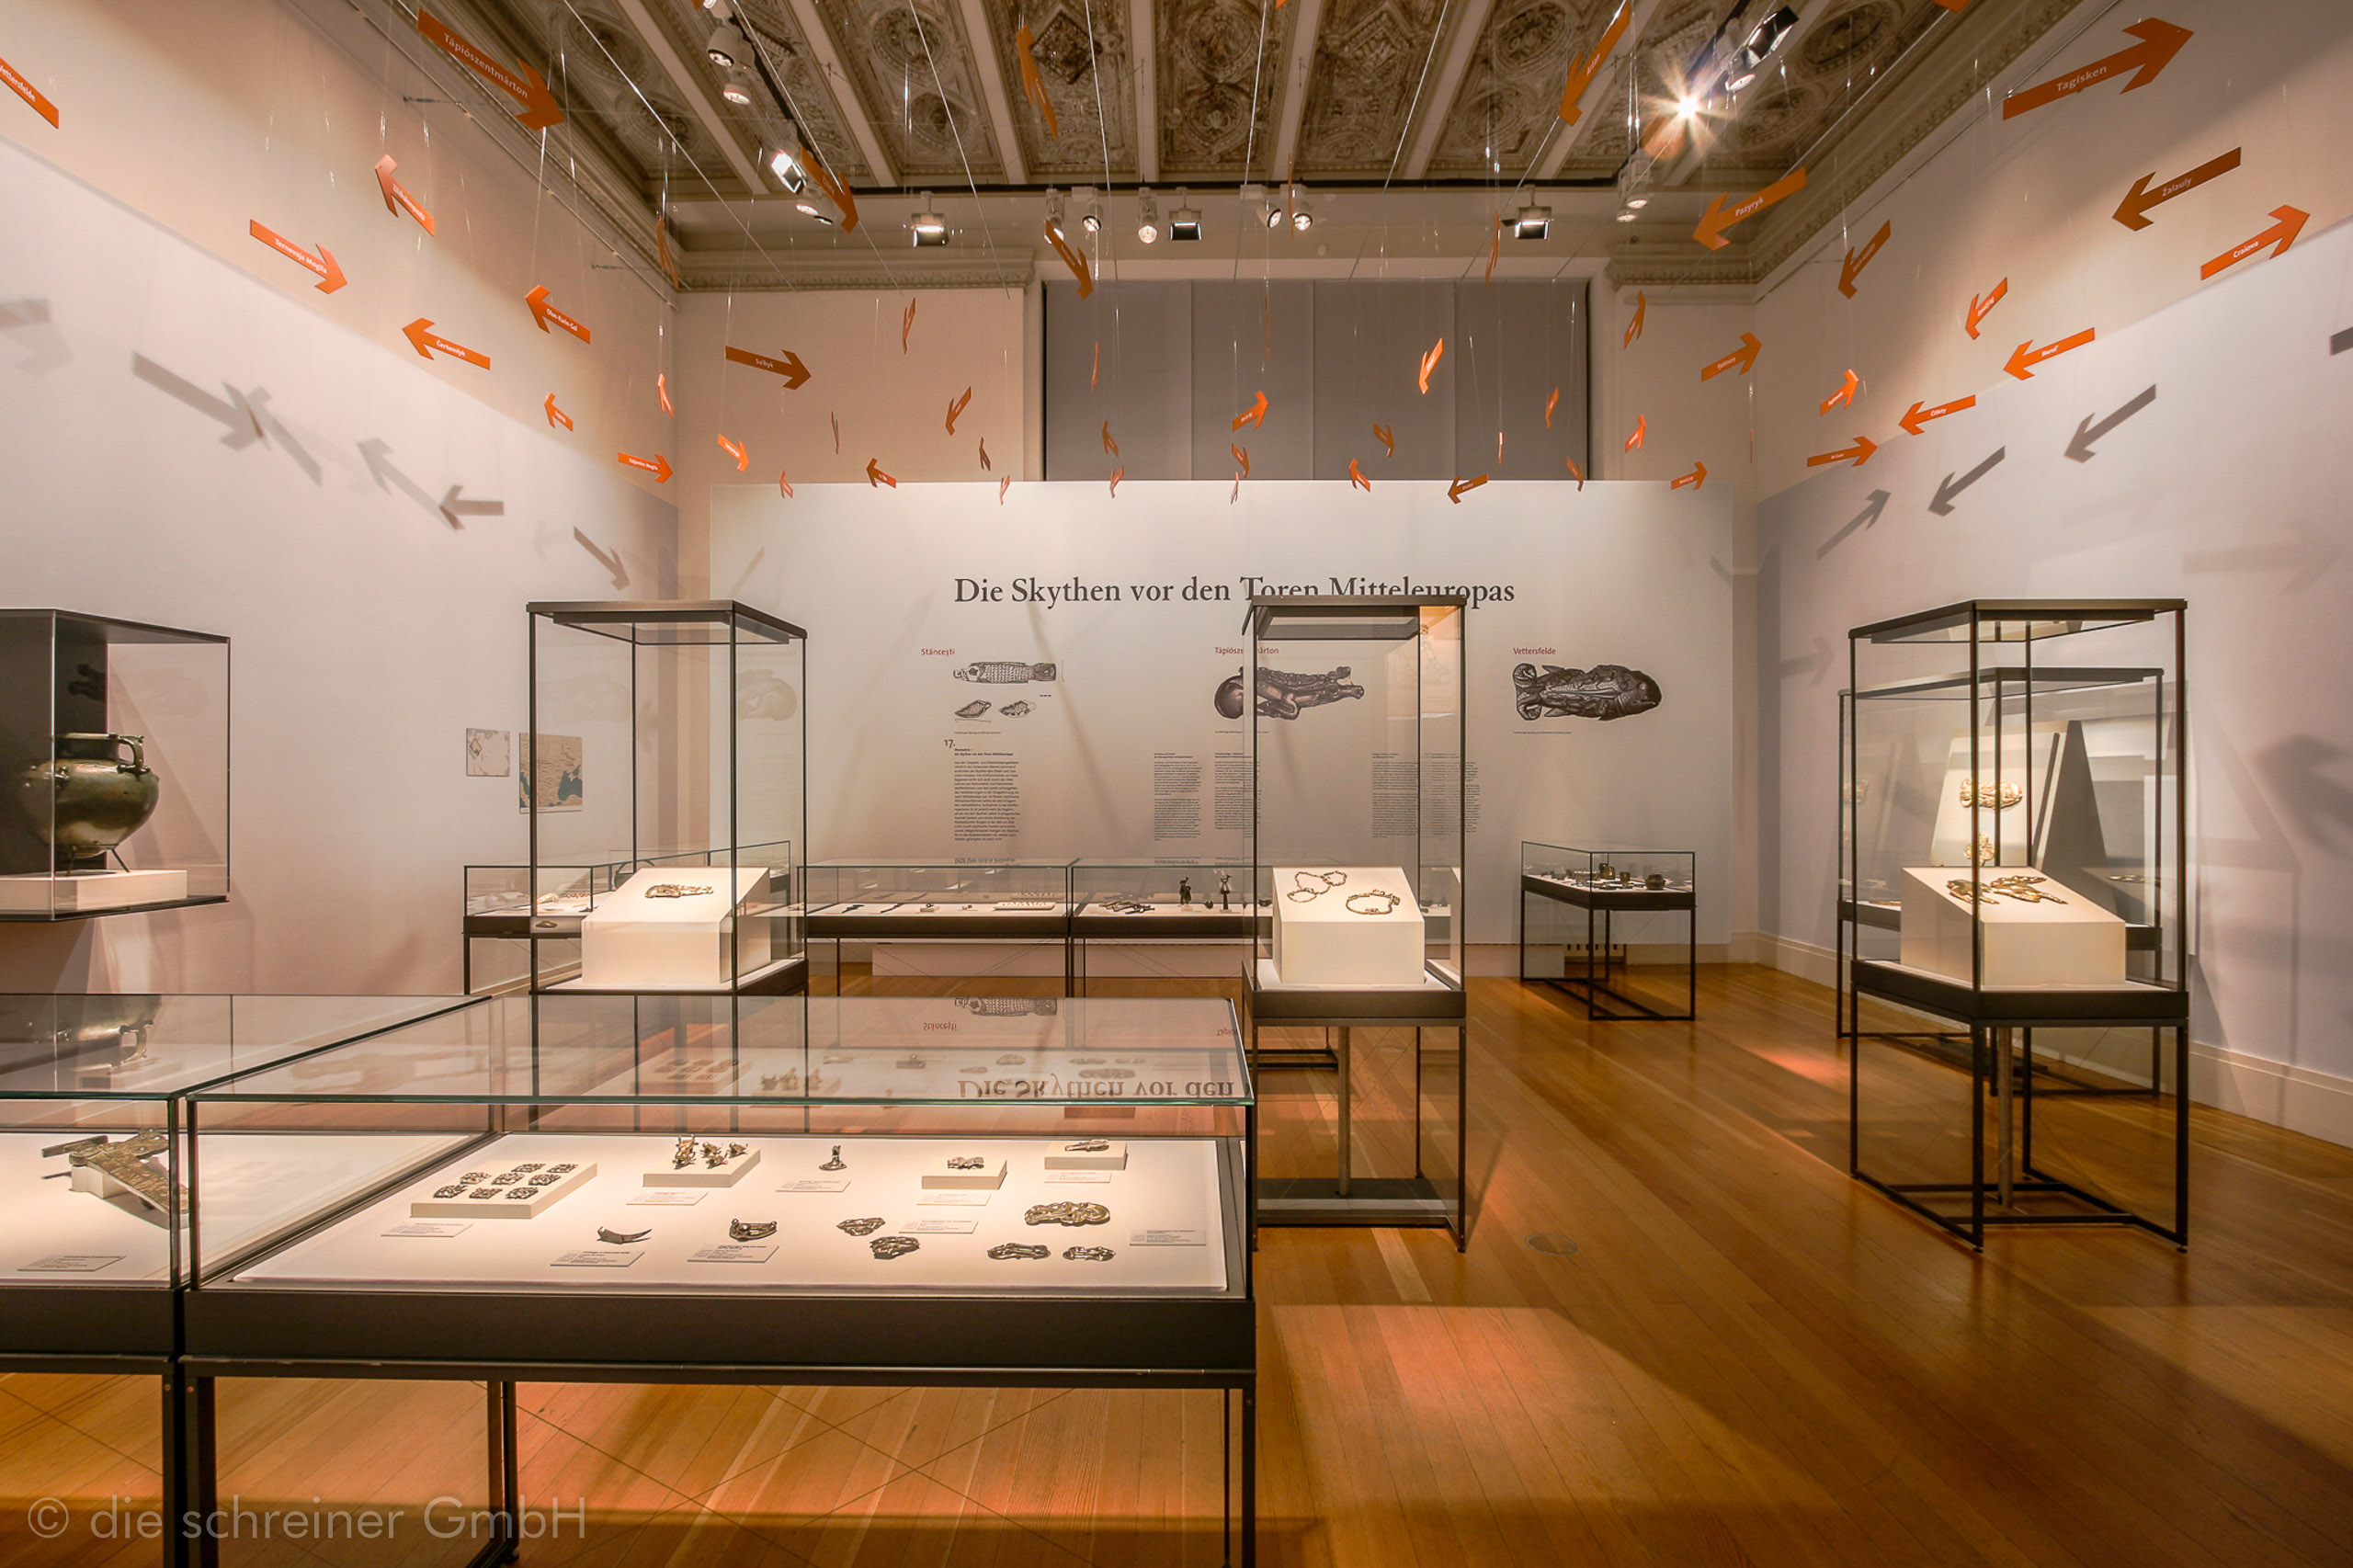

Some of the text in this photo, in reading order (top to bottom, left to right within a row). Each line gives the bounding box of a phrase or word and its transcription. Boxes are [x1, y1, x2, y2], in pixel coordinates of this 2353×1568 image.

[444, 32, 529, 98] Tápiószentmárton
[2056, 65, 2108, 92] Tagisken
[1734, 196, 1765, 217] Pazyryk
[2233, 240, 2260, 258] Craiova
[954, 575, 1515, 610] Die Skythen vor den Toren Mitteleuropas
[1513, 647, 1556, 655] Vettersfelde
[944, 739, 956, 749] 17.
